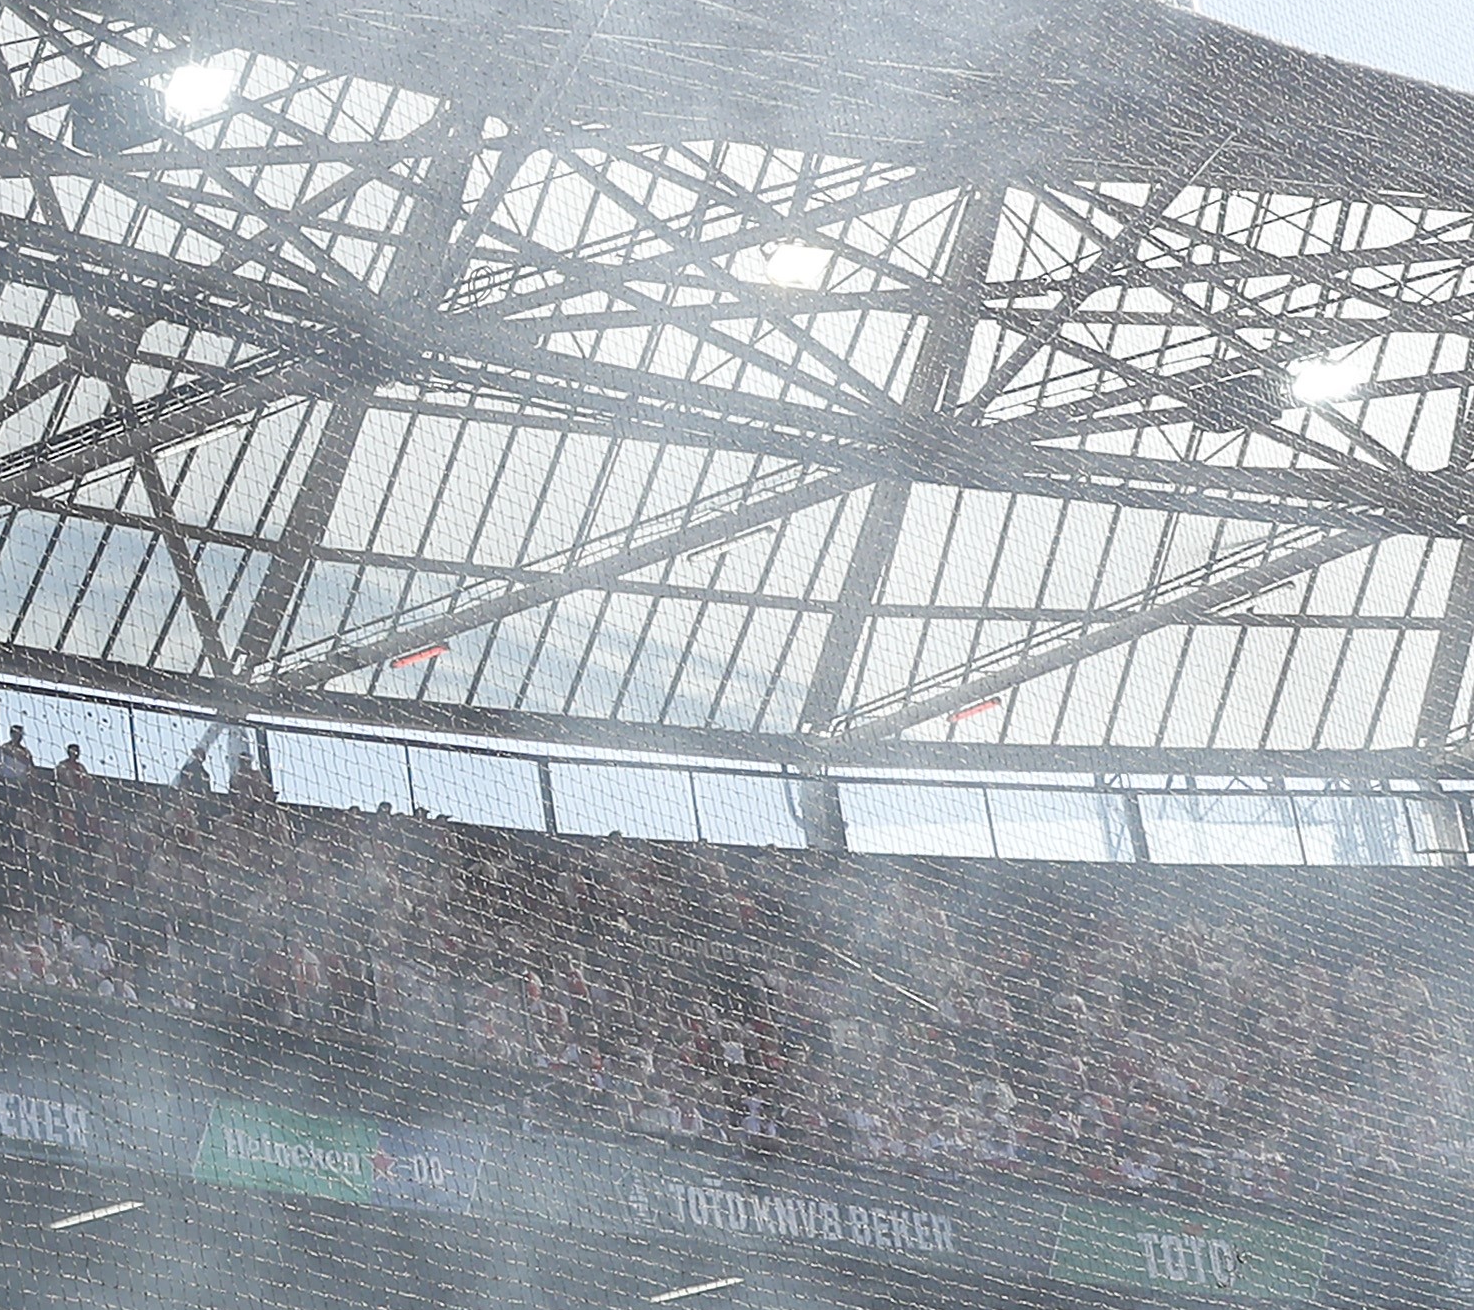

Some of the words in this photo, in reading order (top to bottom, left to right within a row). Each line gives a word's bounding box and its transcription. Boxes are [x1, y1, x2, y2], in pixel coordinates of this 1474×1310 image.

[225, 1127, 363, 1176] Heineken
[667, 1178, 749, 1231] TOTO
[750, 1194, 843, 1240] KNVB
[848, 1204, 956, 1253] BEKER
[1136, 1231, 1237, 1286] TOTO
